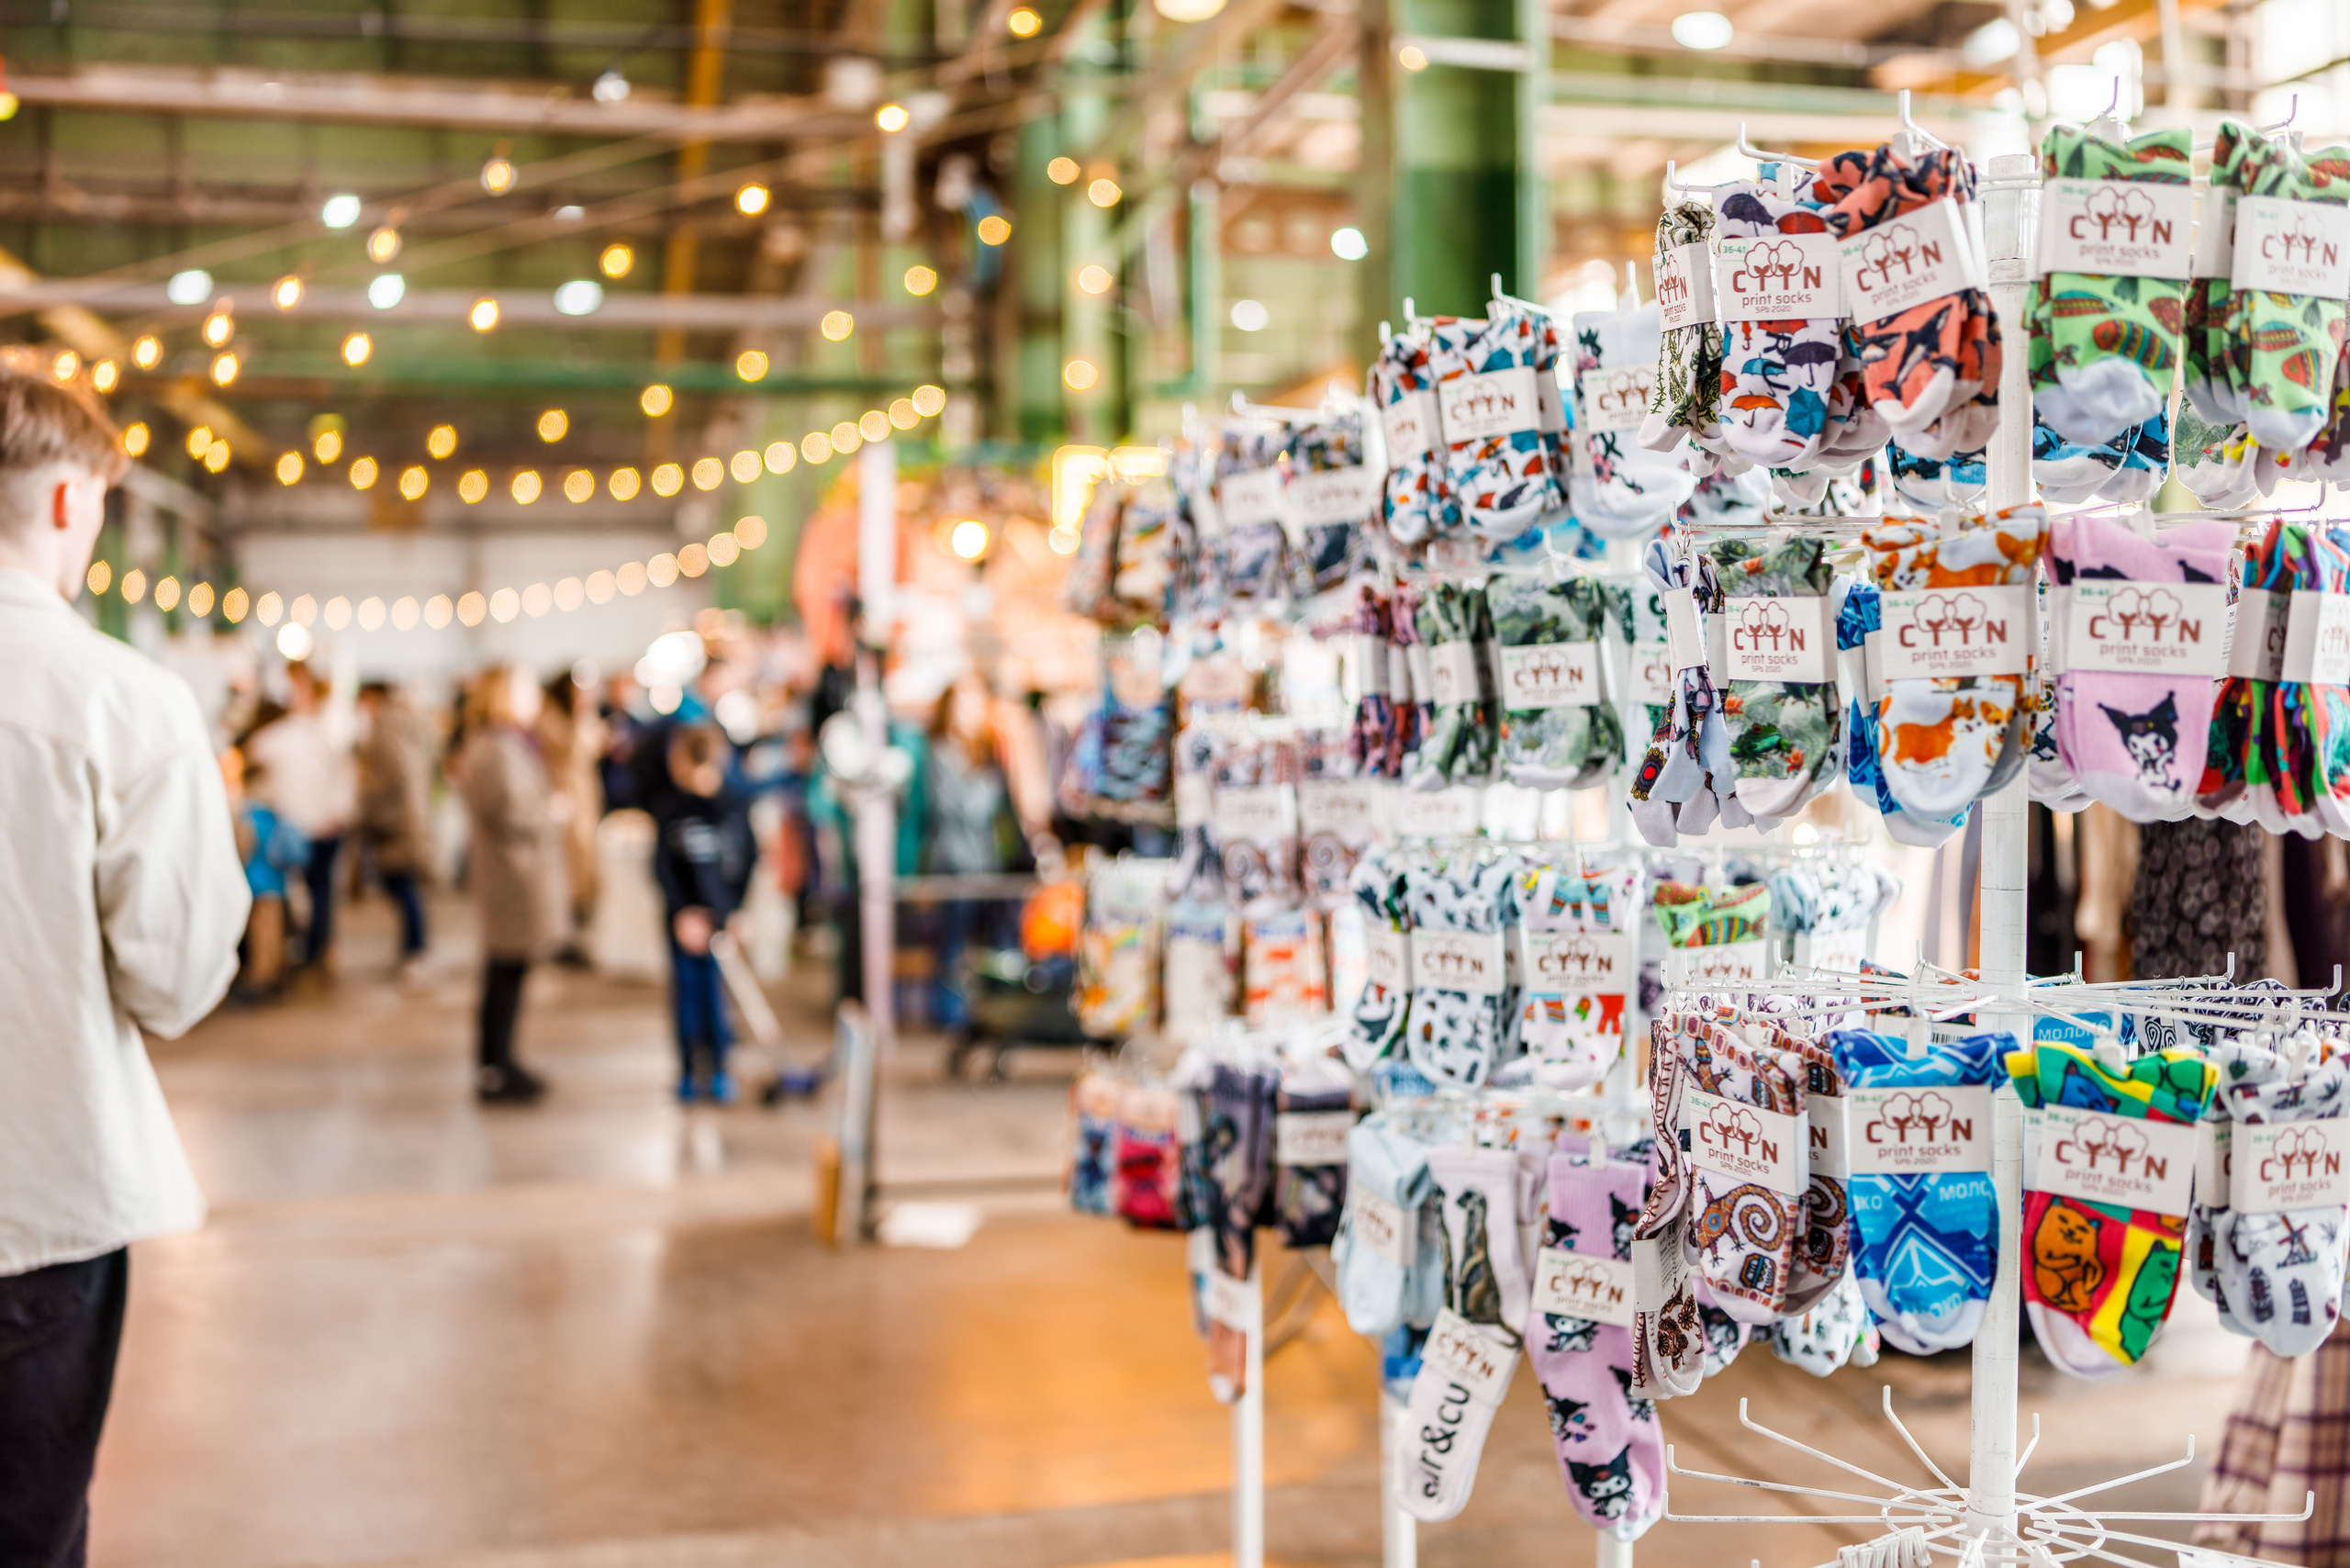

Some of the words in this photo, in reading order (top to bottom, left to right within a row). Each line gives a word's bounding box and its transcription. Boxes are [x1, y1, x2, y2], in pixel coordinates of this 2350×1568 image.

[1742, 293, 1772, 308] print
[1775, 291, 1811, 304] socks
[1911, 648, 1948, 664] print
[1953, 646, 1997, 659] socks
[2099, 643, 2137, 657] print
[2143, 644, 2187, 657] socks
[1741, 652, 1764, 666] print
[1768, 653, 1798, 665] socks
[1878, 1145, 1913, 1159] print
[1919, 1145, 1961, 1156] socks
[1708, 1148, 1735, 1163] print
[1738, 1157, 1770, 1174] socks
[1720, 1161, 1733, 1170] SPb
[1734, 1166, 1751, 1176] 2020
[2065, 1168, 2102, 1182] print
[2108, 1177, 2152, 1193] socks
[2268, 1183, 2296, 1199] print
[2300, 1179, 2331, 1193] socks
